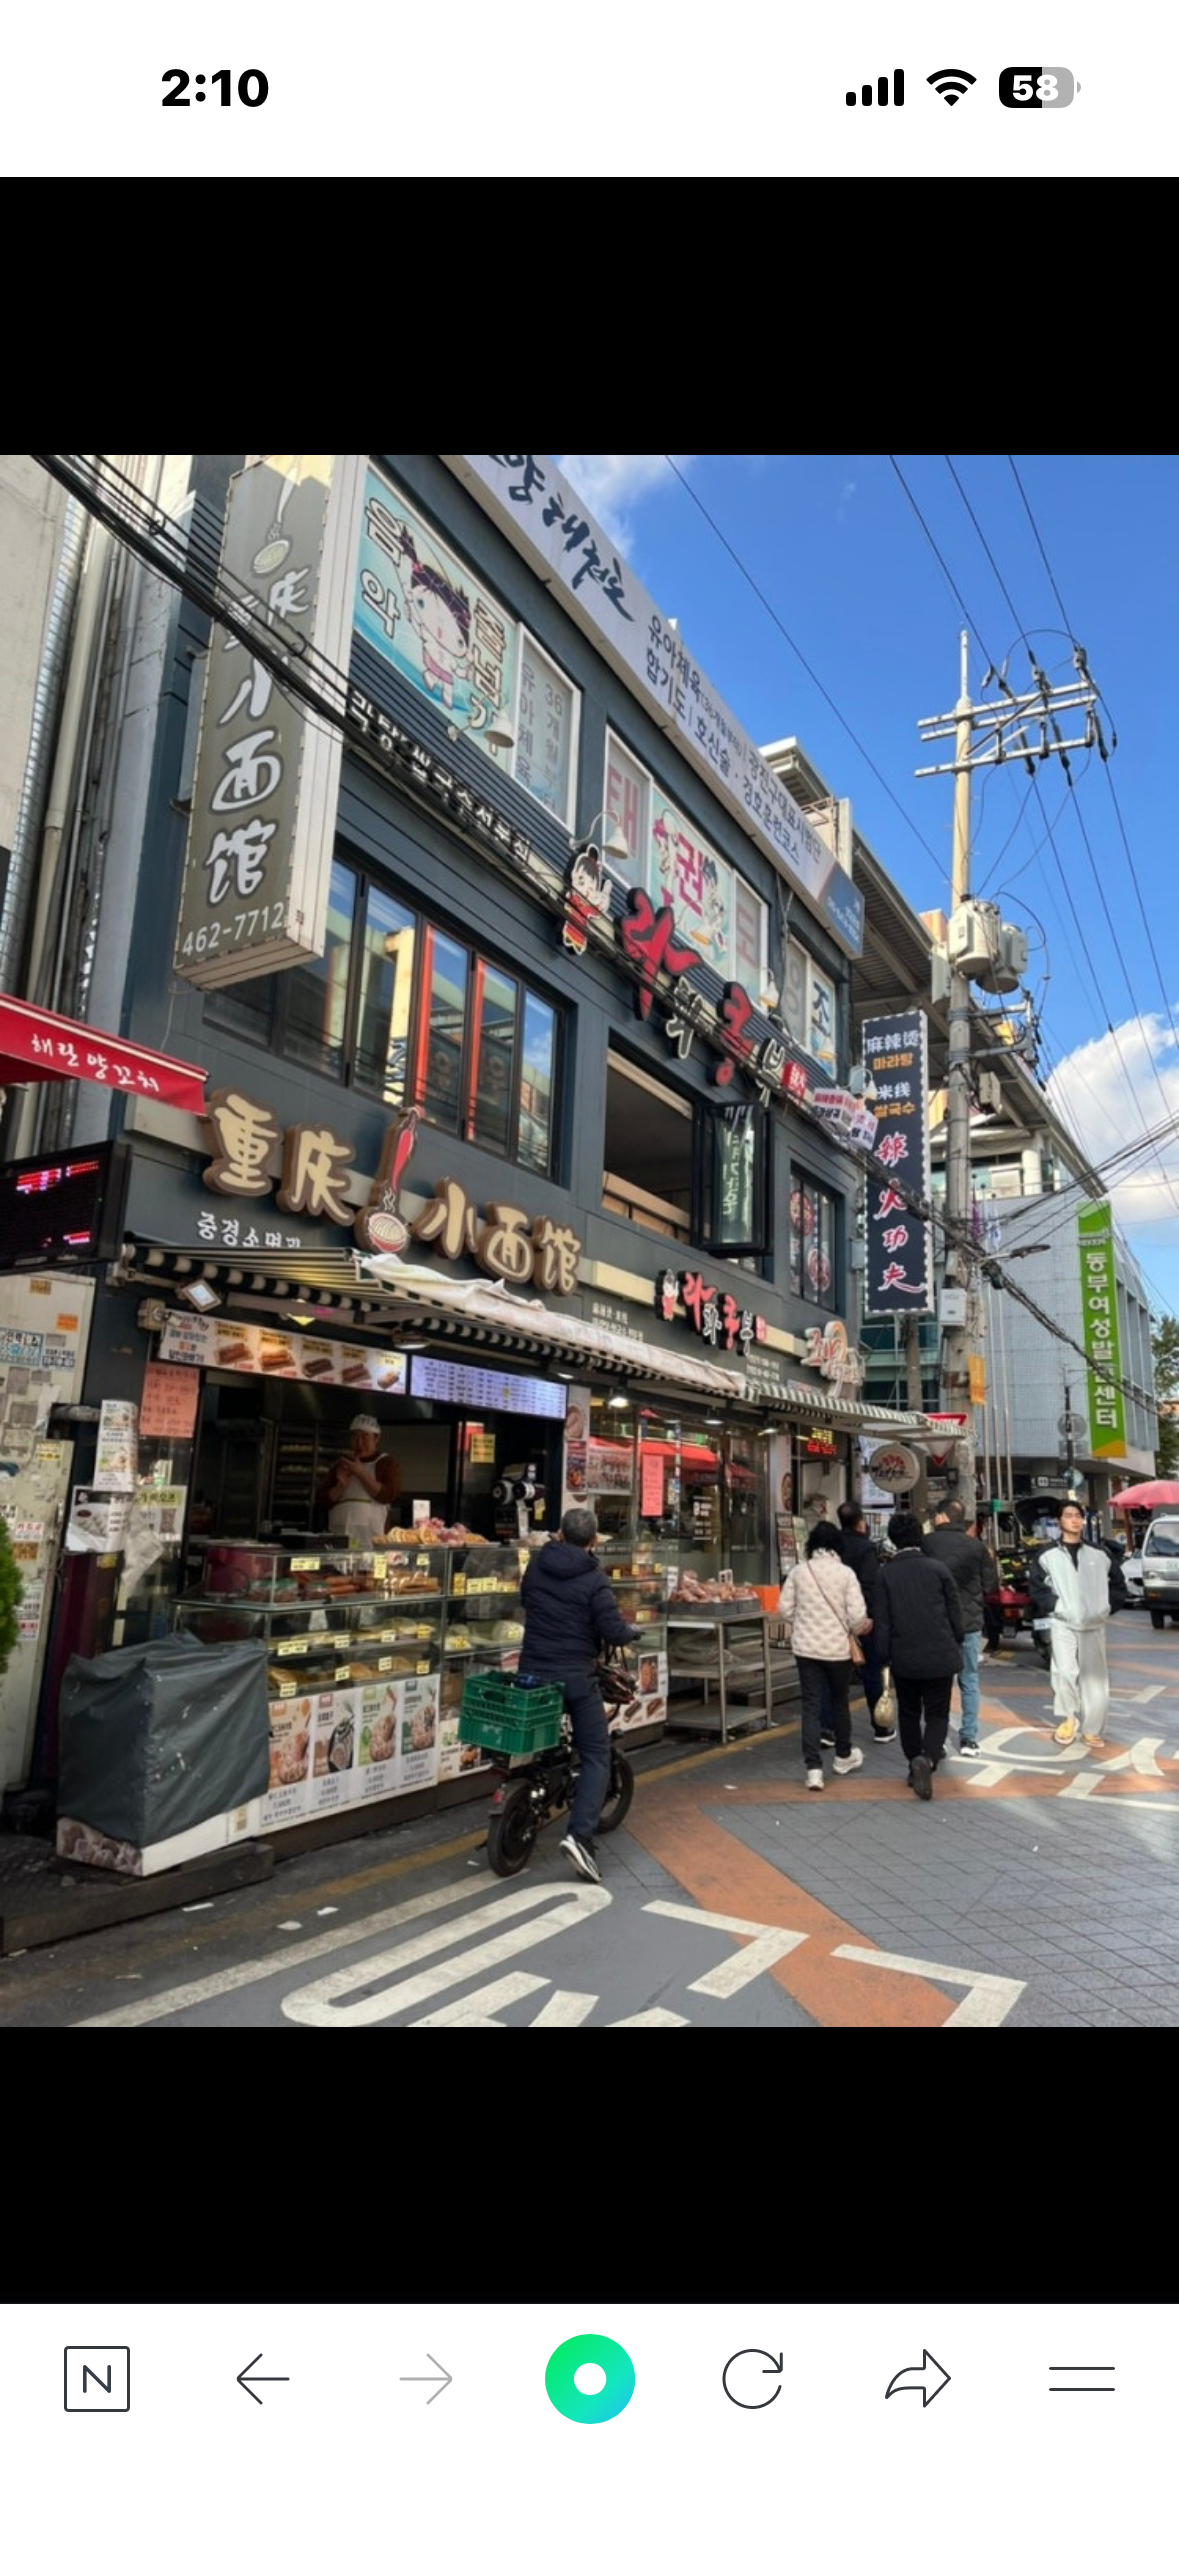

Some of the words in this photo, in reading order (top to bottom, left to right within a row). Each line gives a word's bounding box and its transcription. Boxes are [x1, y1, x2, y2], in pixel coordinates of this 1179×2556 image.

[360, 497, 402, 638] 음악
[515, 662, 536, 787] 유아체육
[646, 647, 686, 720] 합기도
[695, 713, 731, 781] 호신술
[181, 903, 285, 957] 462-7712
[873, 1052, 914, 1072] 마라탕
[873, 1101, 916, 1120] 쌀국수
